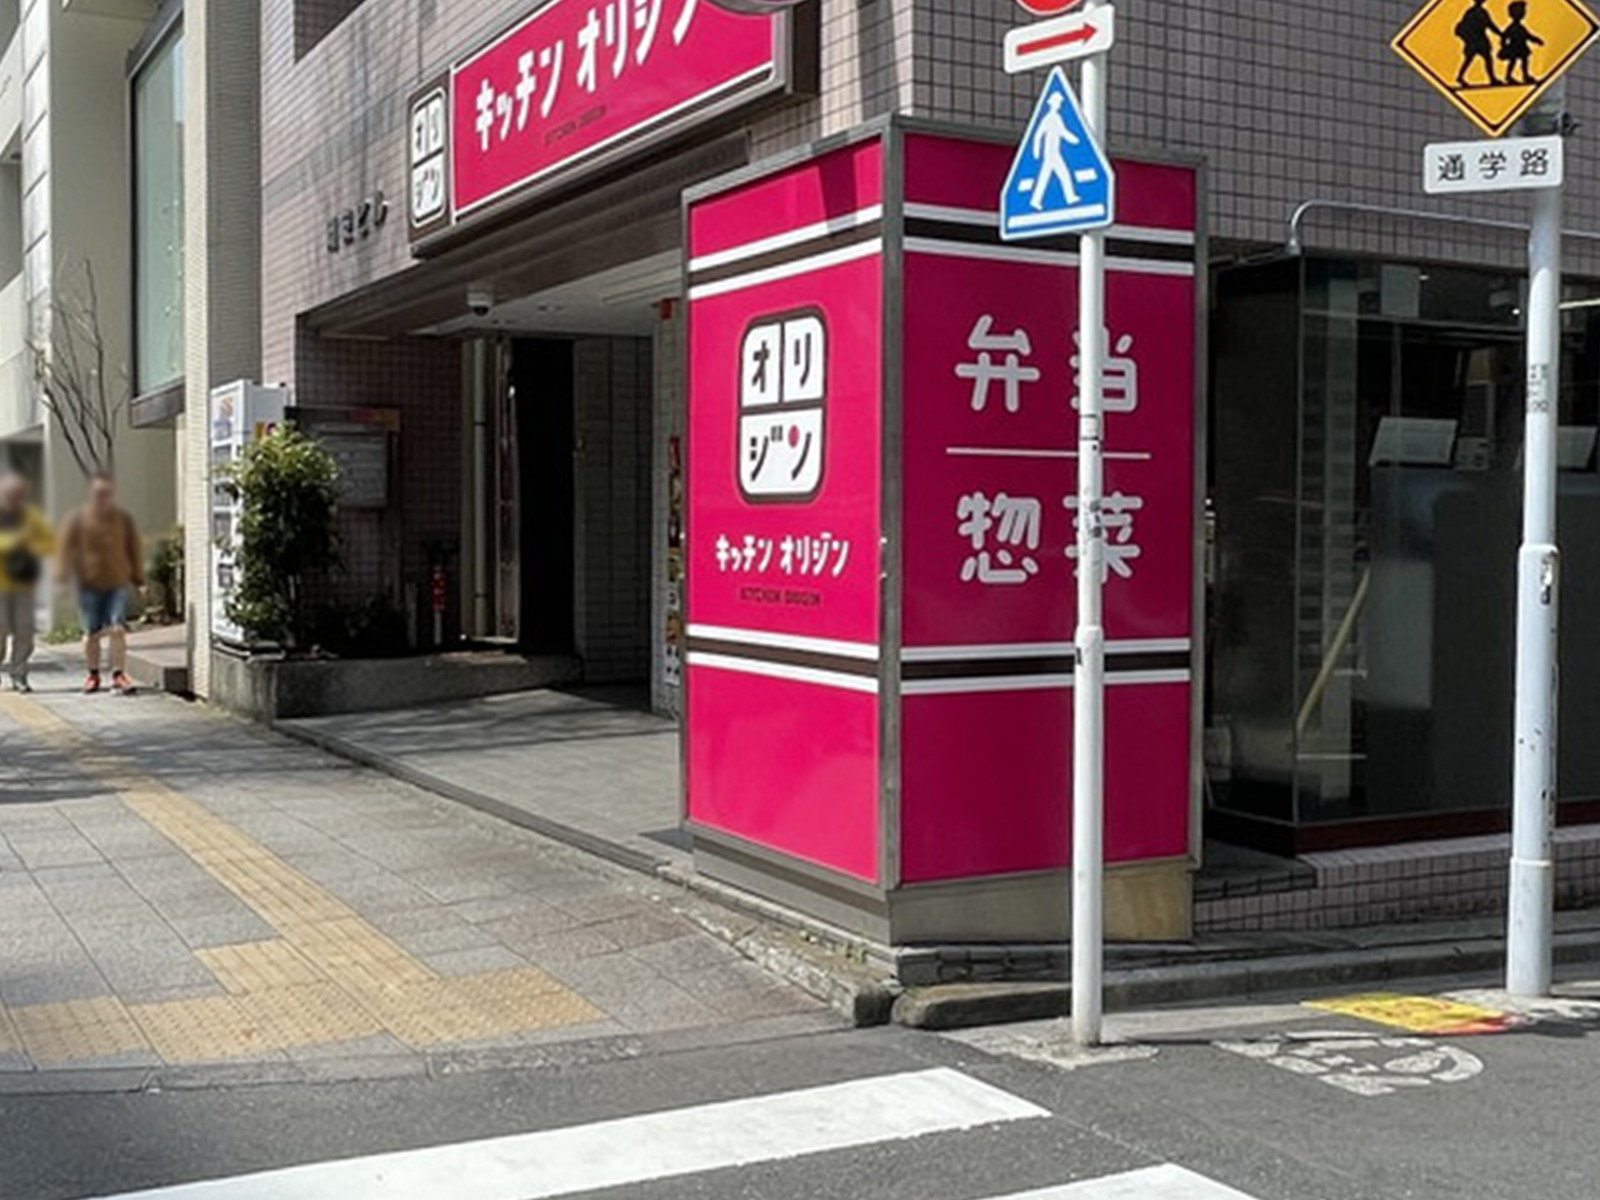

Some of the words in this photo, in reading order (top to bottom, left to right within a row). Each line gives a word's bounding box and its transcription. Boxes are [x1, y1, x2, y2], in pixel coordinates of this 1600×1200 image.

[475, 39, 565, 152] キッチン
[1437, 148, 1549, 182] 通学路
[715, 533, 773, 573] キッチン
[780, 531, 849, 578] オリジン
